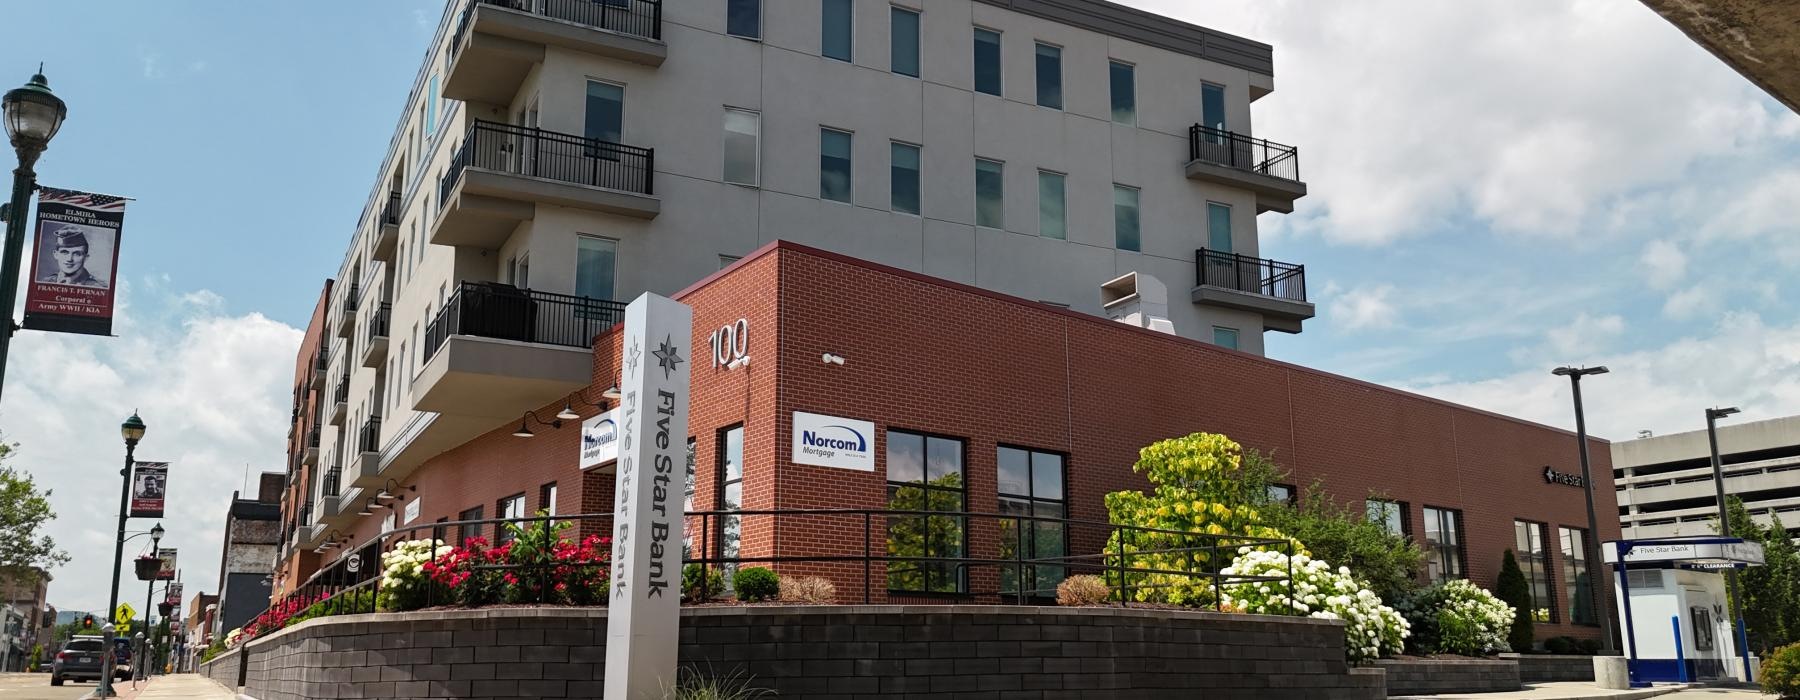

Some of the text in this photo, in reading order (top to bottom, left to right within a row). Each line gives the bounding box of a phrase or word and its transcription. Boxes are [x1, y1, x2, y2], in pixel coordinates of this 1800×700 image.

[65, 208, 96, 218] ELMIRA
[40, 211, 120, 228] HOMETOWN HEROES
[37, 285, 68, 293] FRANCIS
[55, 295, 86, 304] Corporal
[38, 303, 59, 311] Army
[60, 304, 80, 312] WWII
[708, 318, 748, 368] 100
[803, 430, 857, 451] Norcom
[803, 447, 835, 458] Mortgage
[615, 391, 636, 599] Five Star Bank
[648, 388, 675, 600] Five Star Bank
[1672, 544, 1689, 552] Bank
